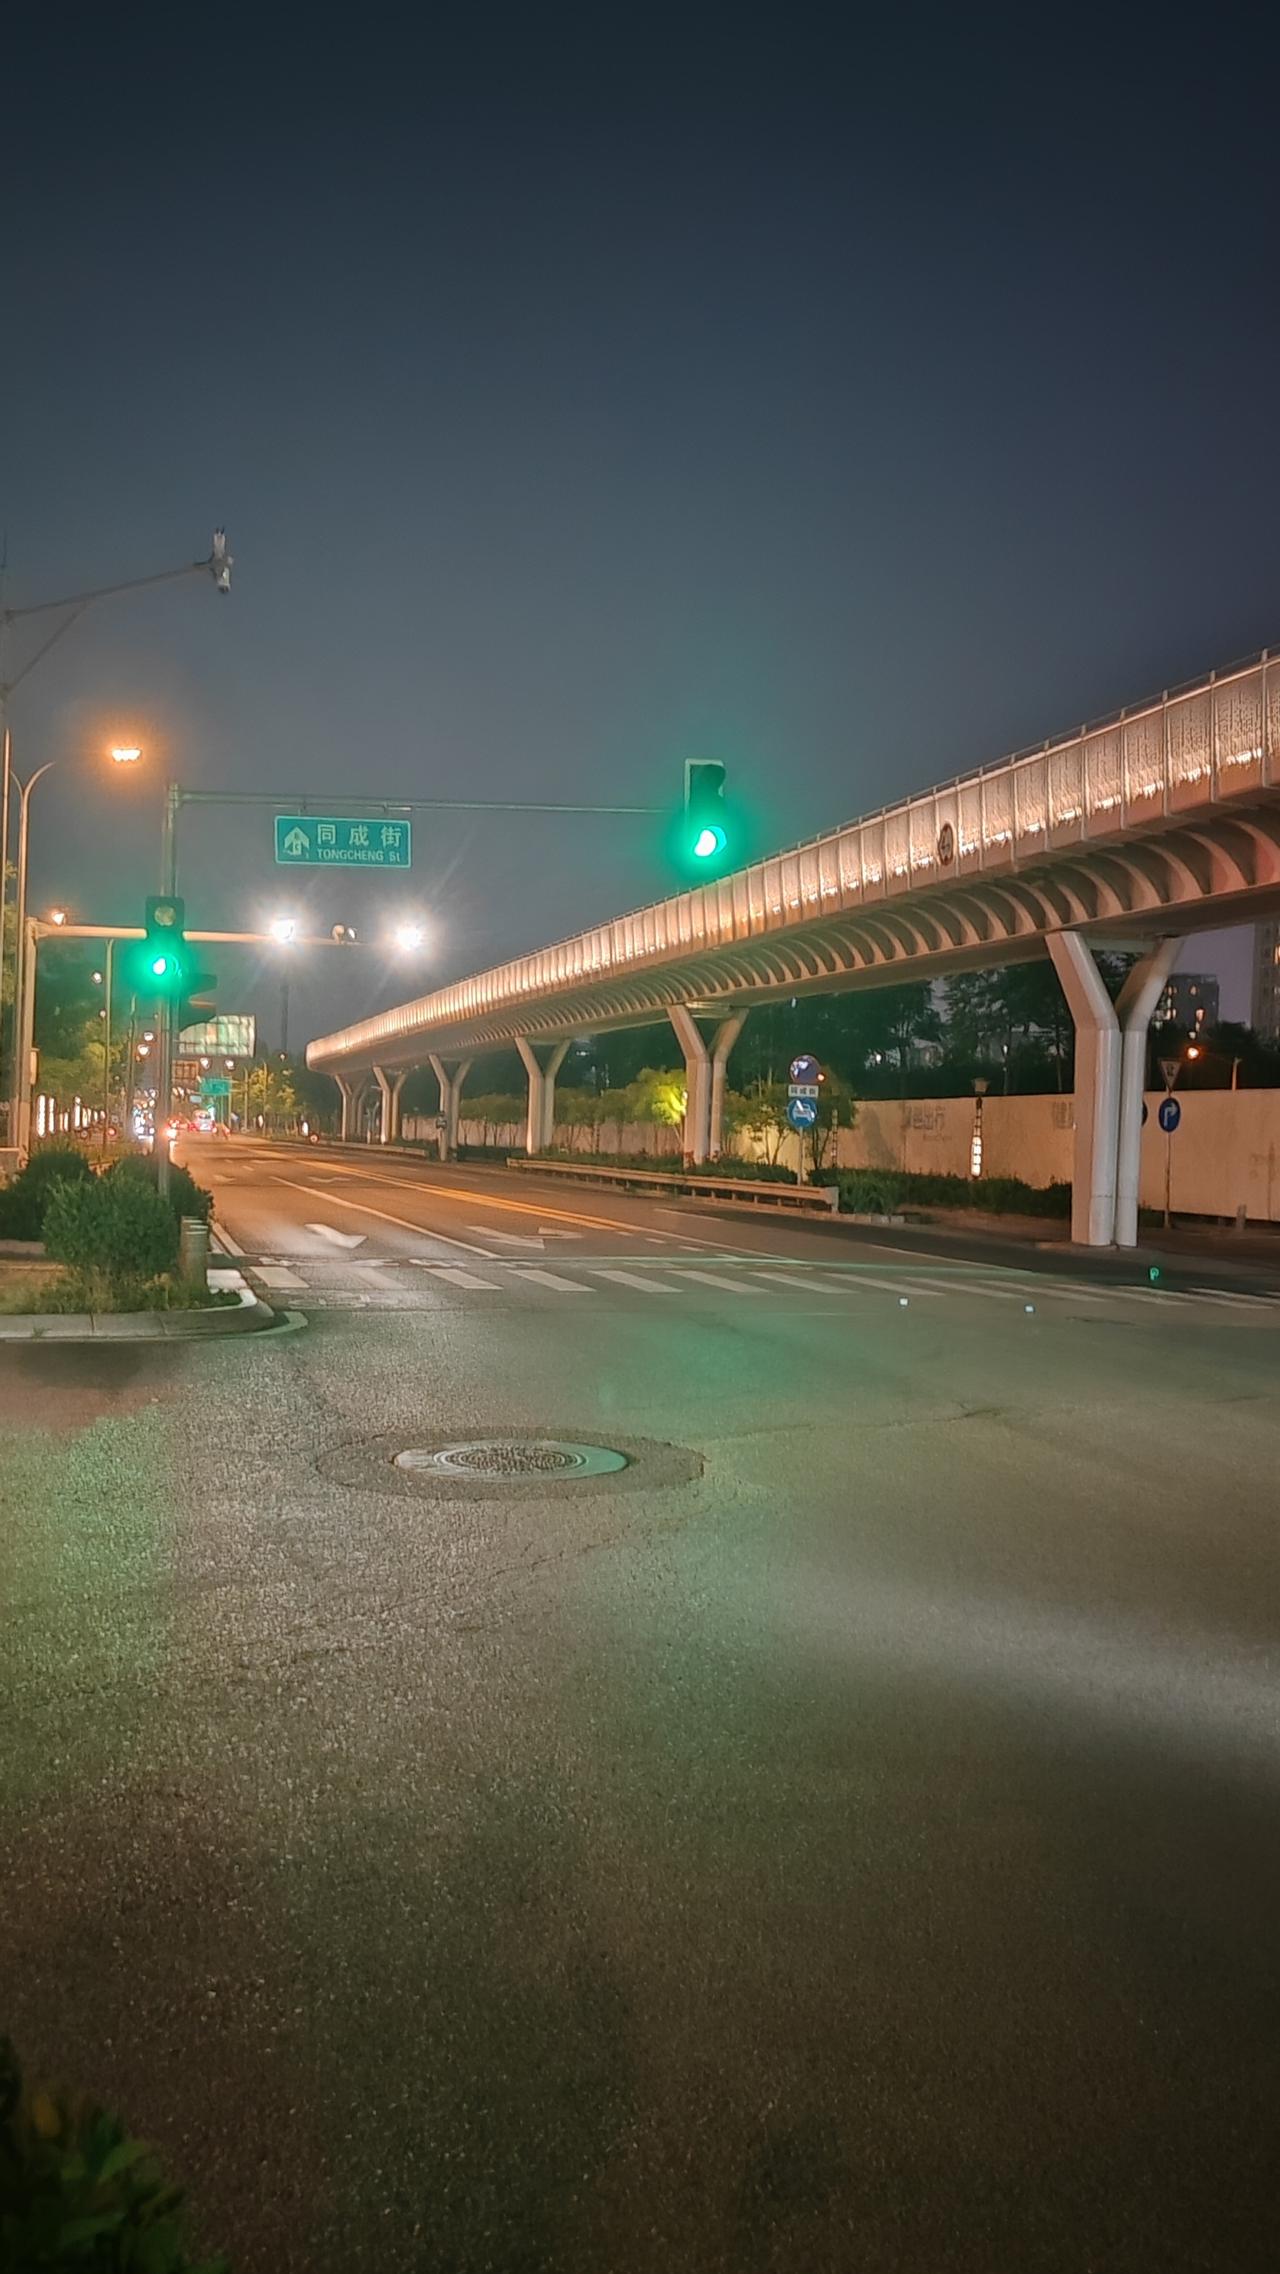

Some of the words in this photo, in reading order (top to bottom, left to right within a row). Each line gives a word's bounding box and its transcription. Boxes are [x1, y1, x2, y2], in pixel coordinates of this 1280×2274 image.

[317, 824, 401, 847] 同成街
[317, 849, 384, 862] TONGCHENG
